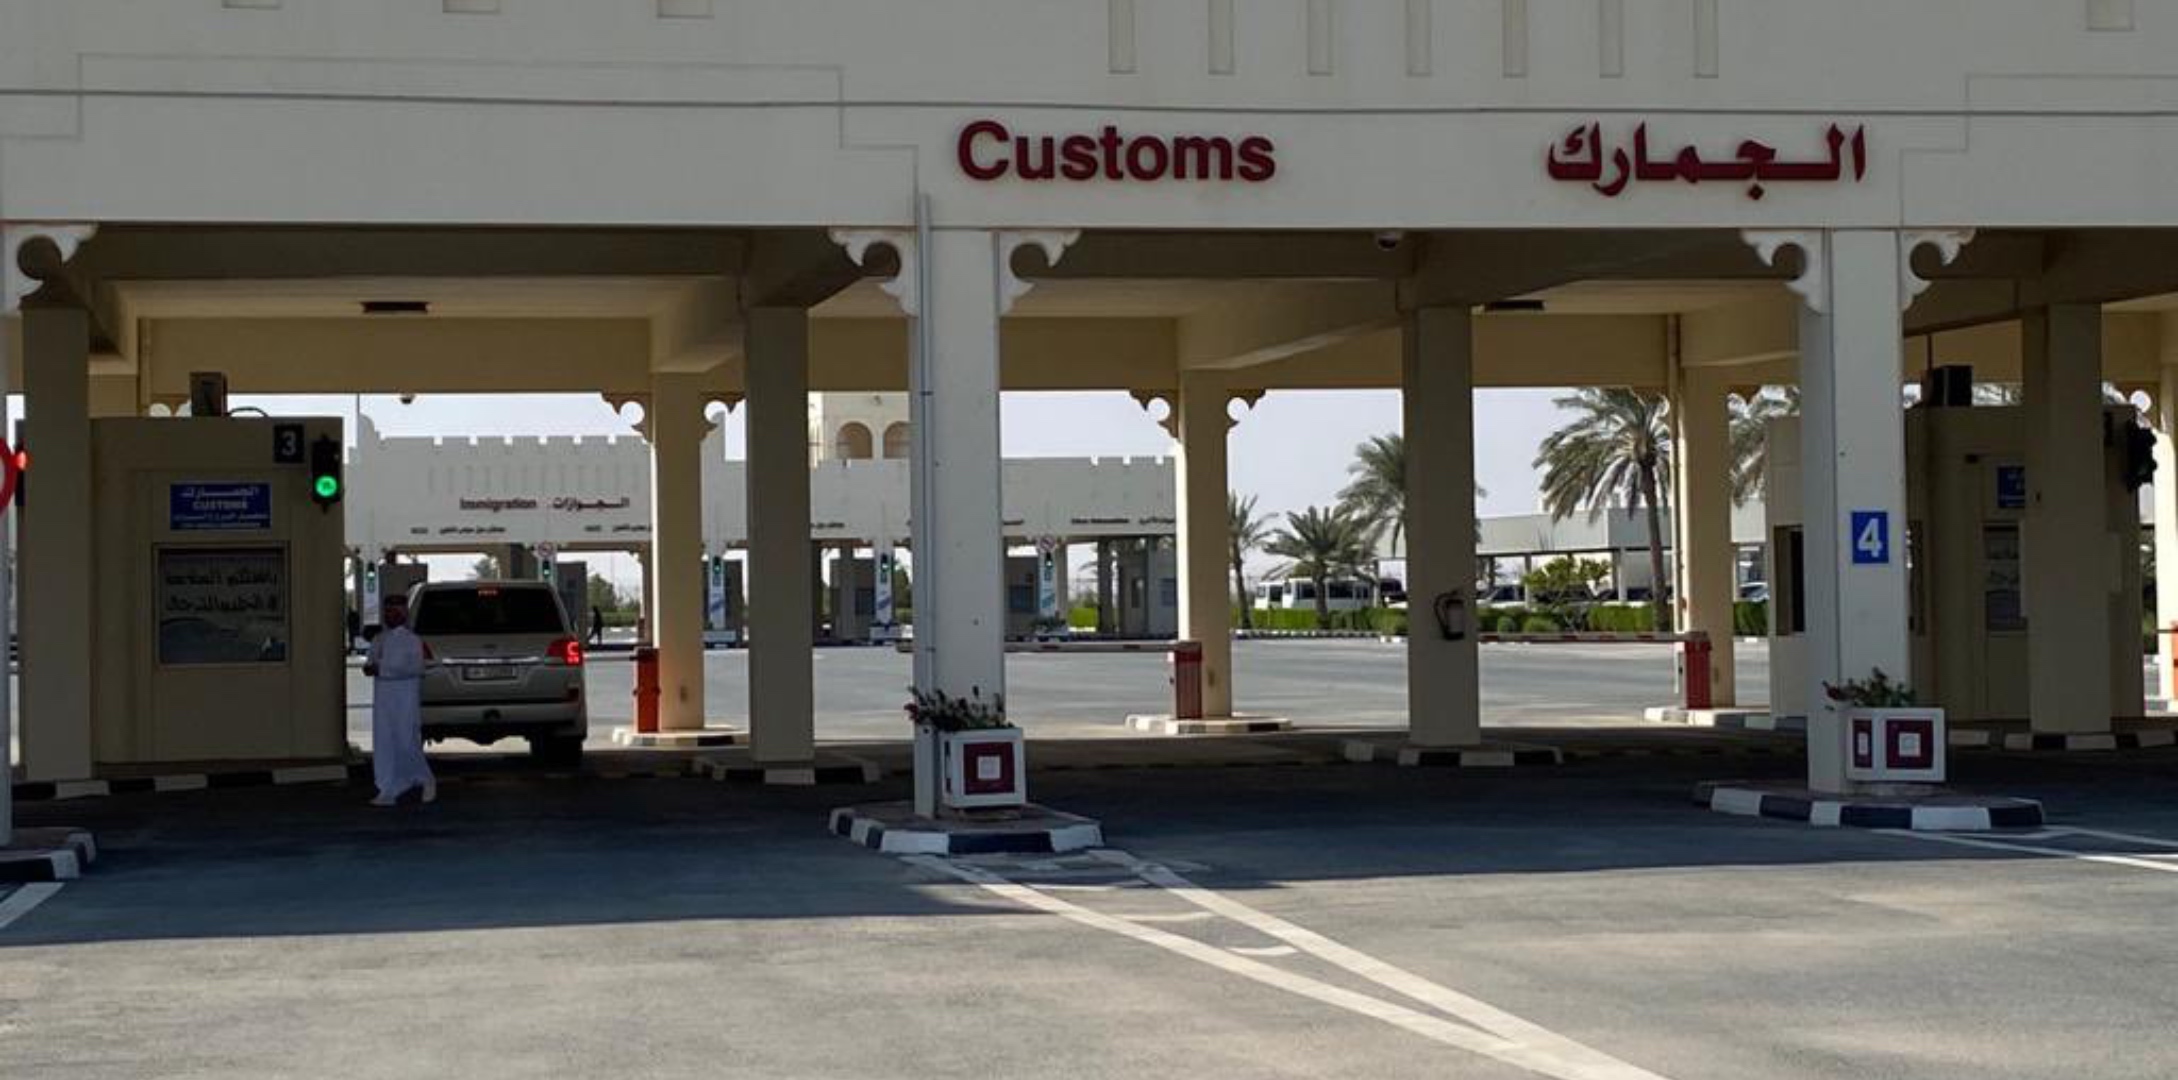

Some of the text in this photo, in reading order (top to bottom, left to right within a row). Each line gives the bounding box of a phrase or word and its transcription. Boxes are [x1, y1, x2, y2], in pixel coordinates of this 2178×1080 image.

[957, 120, 1276, 182] Customs
[1547, 121, 1866, 200] الجمارك
[281, 431, 297, 456] 3
[459, 497, 537, 513] Immigration
[1857, 518, 1883, 557] 4
